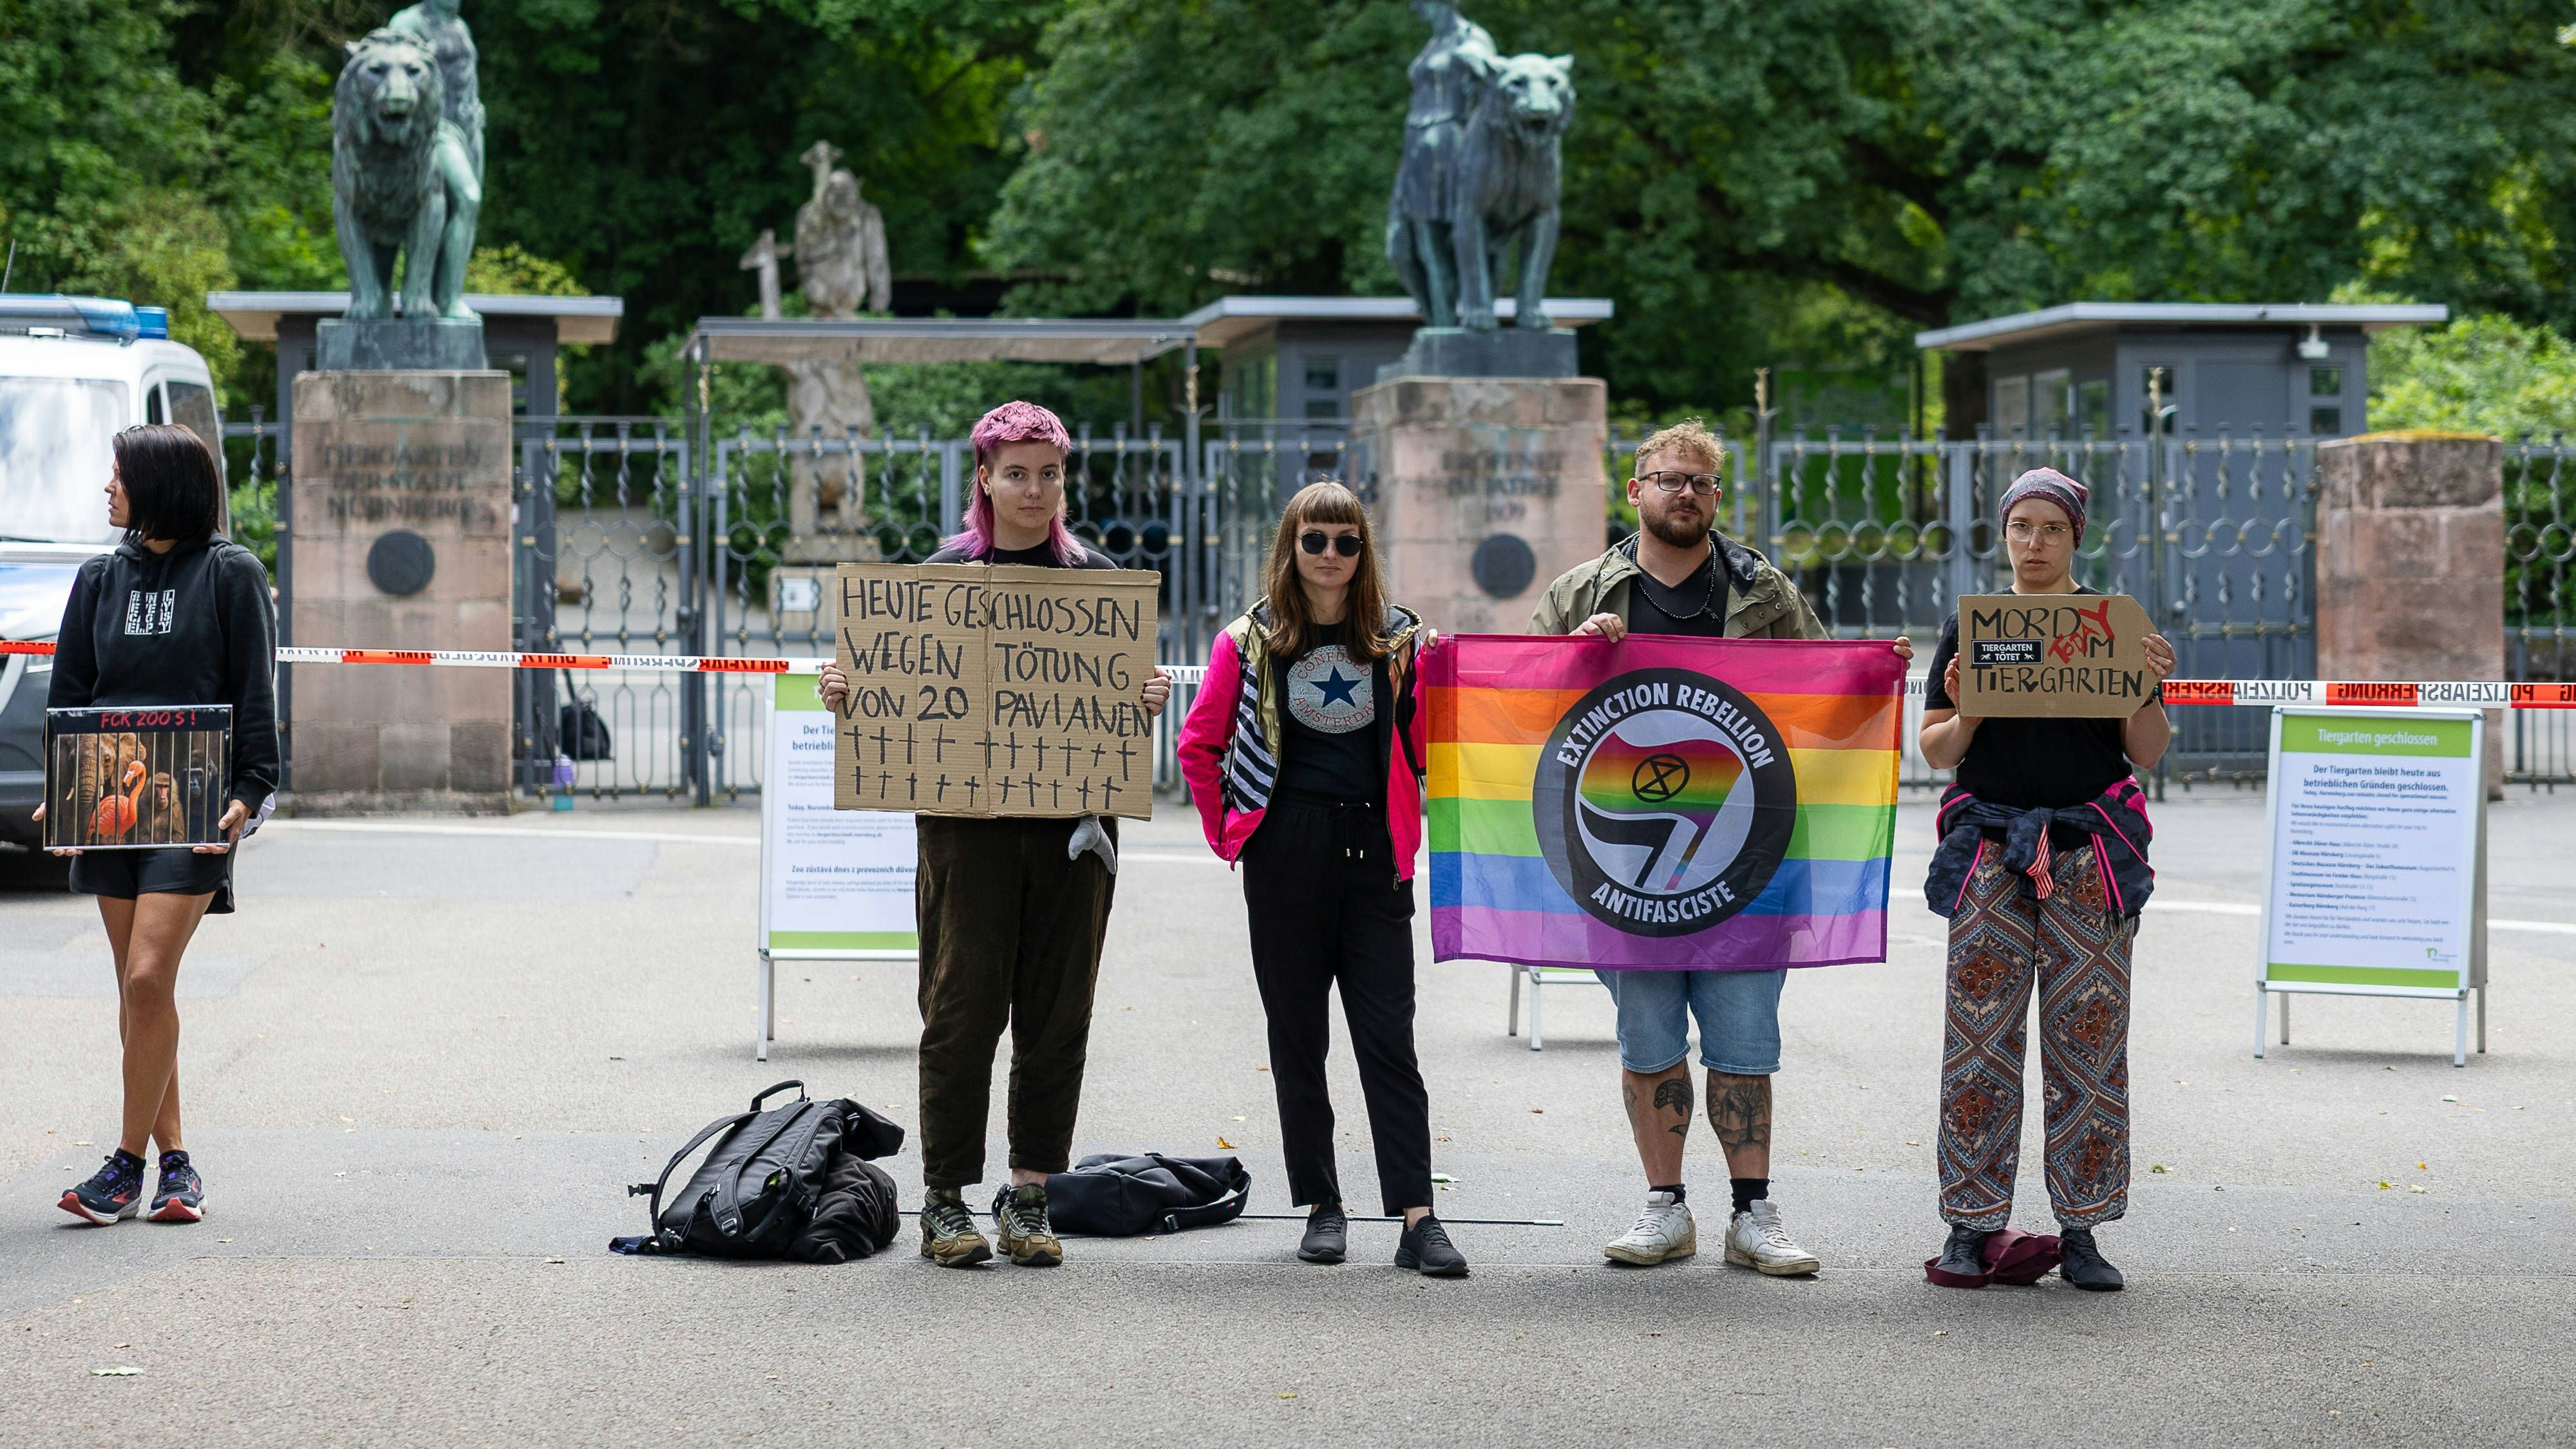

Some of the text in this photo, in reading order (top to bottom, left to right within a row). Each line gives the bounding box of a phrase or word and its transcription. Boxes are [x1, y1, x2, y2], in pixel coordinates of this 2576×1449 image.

[842, 577, 1139, 641] HEUTE GESCHLOSSEN
[1971, 607, 2082, 639] MORD
[844, 627, 1131, 691] WEGEN TÖTUNG
[1994, 652, 2020, 661] TÖTET
[1969, 664, 2143, 698] TIERGARTEN
[100, 712, 131, 729] FCK
[841, 686, 905, 720] VON
[917, 685, 969, 721] 20
[994, 690, 1153, 737] PAVIANEN
[1556, 683, 1775, 770] EXTINCTION REBELLION
[792, 740, 835, 750] betriebli
[2318, 728, 2438, 747] Tiergarten geschlossen
[2304, 778, 2448, 793] betrieblichen Gründen geschlossen.
[2313, 764, 2327, 773] Der
[2329, 765, 2372, 777] Tiergarten
[2374, 766, 2398, 776] bleibt
[2400, 768, 2425, 777] heute
[1590, 880, 1736, 924] ANTIFASCISTE
